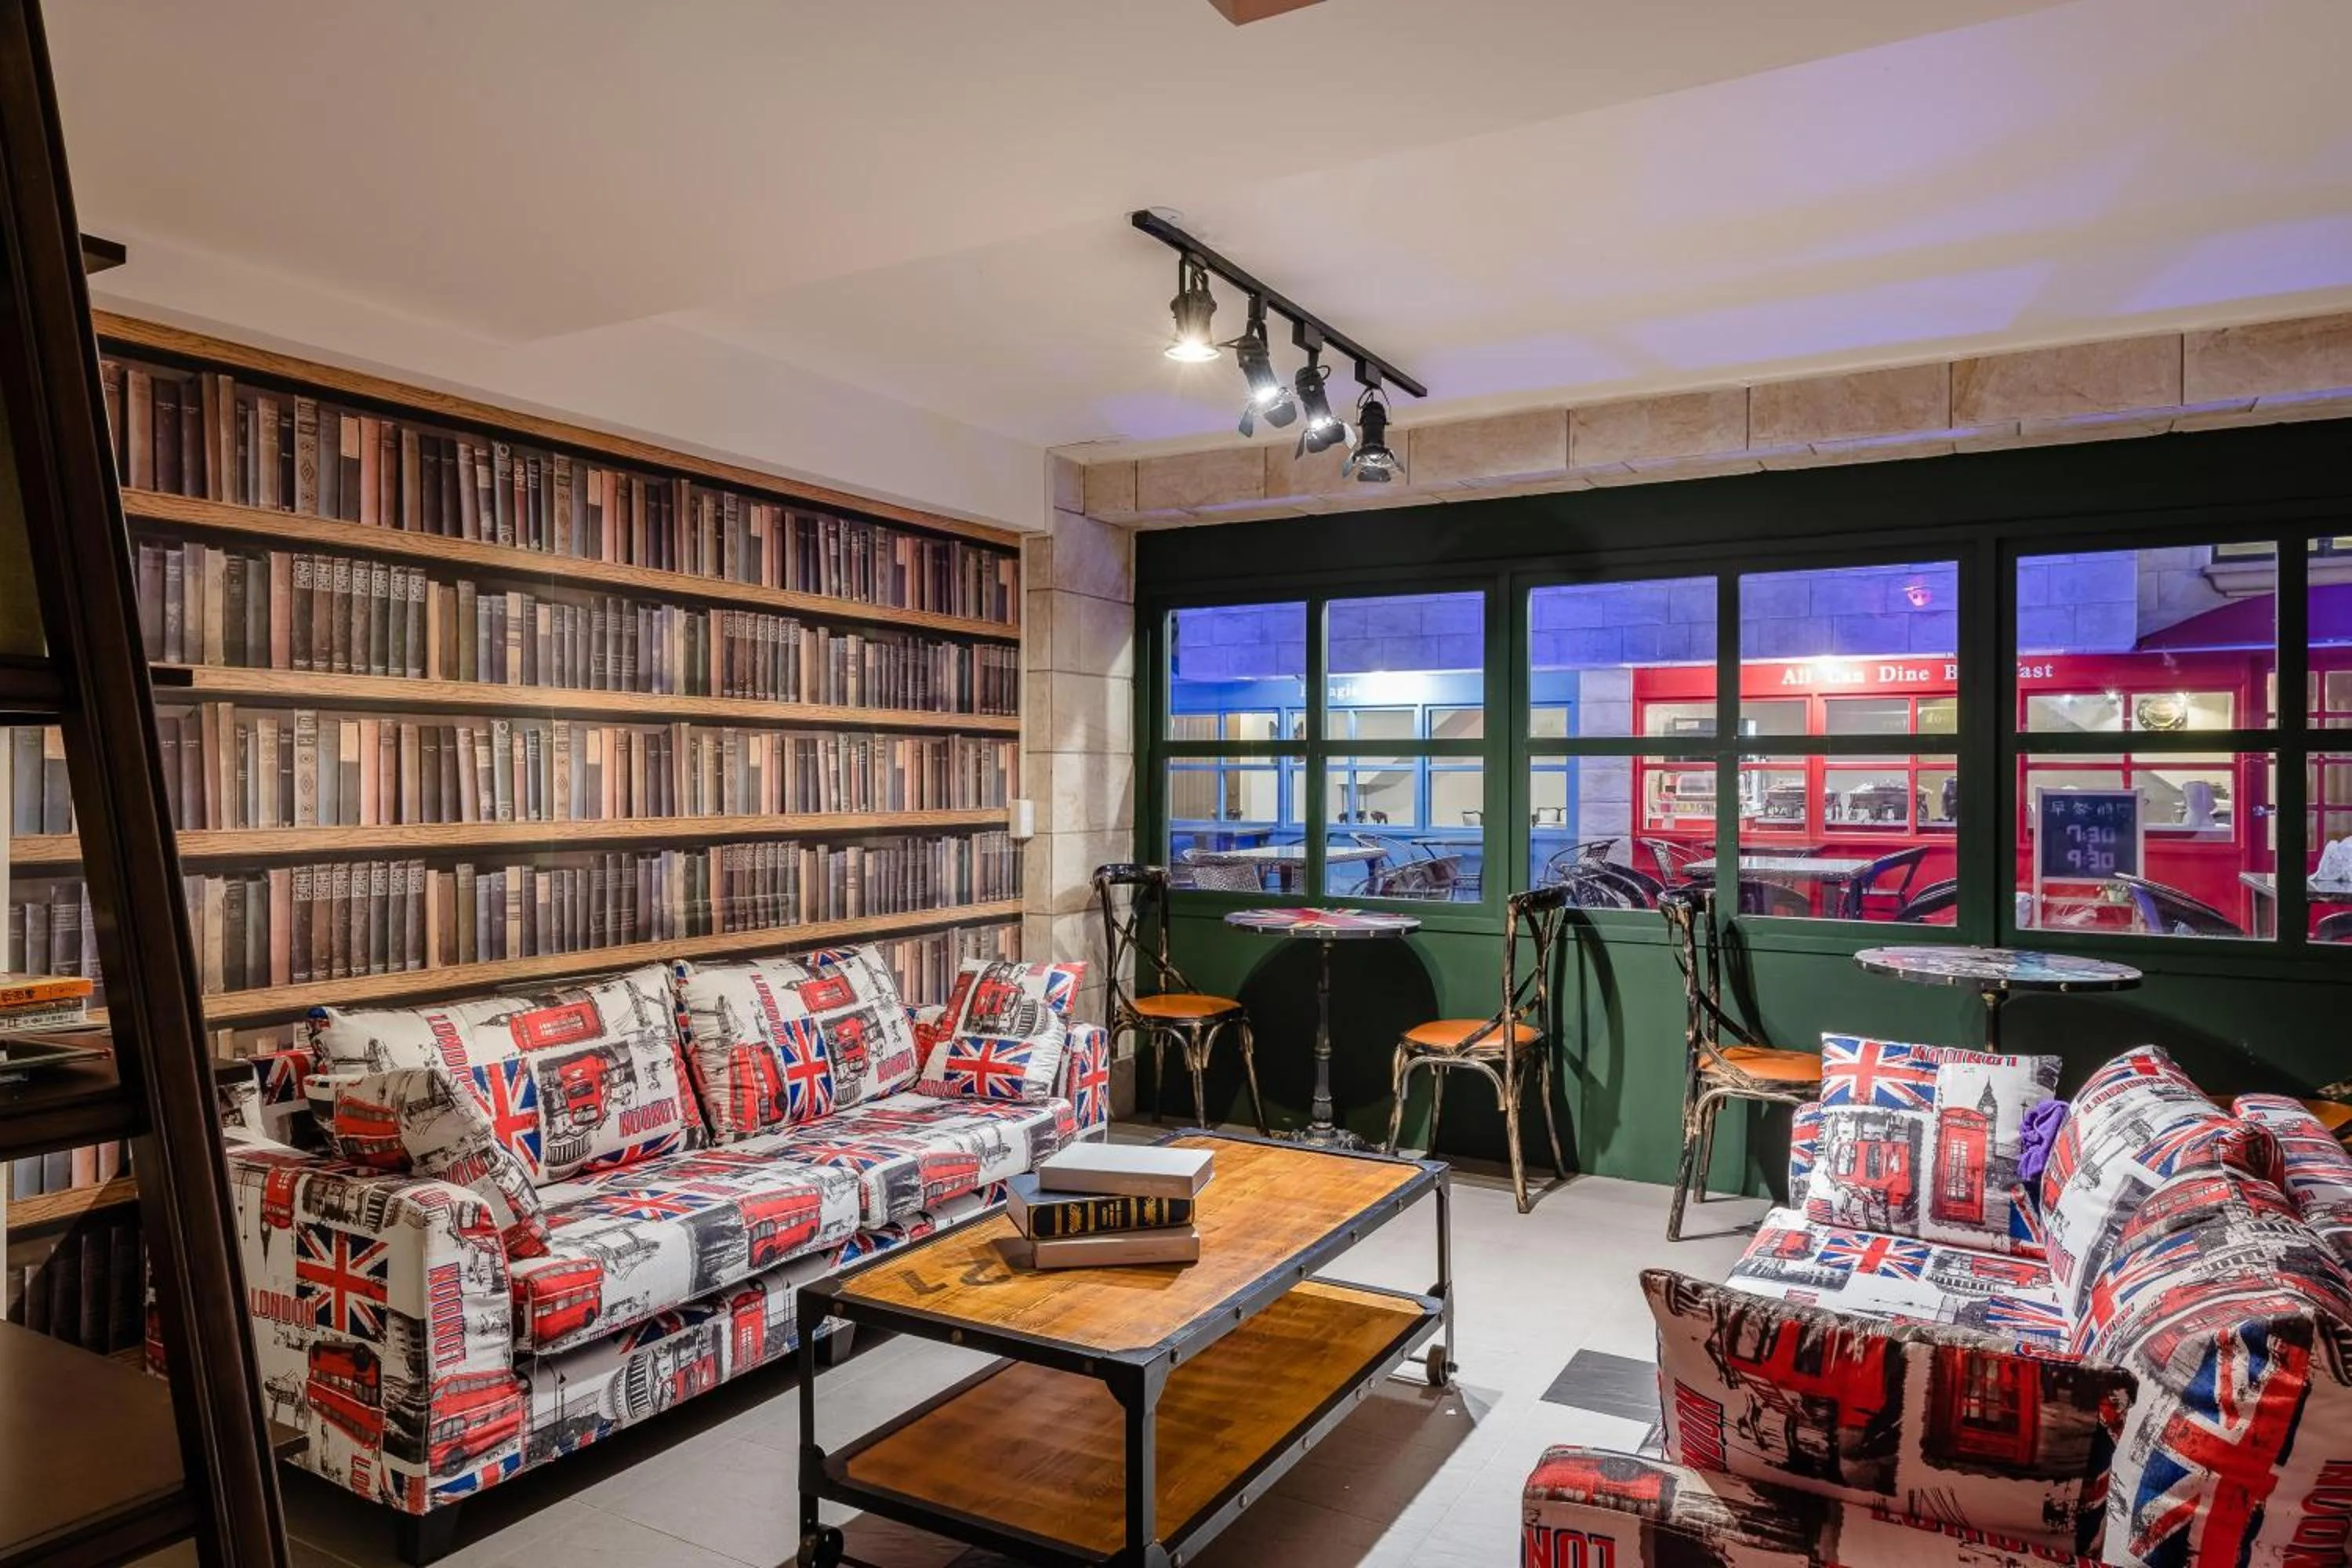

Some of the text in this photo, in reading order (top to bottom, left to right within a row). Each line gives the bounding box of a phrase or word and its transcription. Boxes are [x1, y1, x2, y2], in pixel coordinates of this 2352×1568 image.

[1780, 665, 1813, 685] All
[1878, 666, 1930, 683] Dine
[2066, 824, 2116, 844] 7:30
[2067, 849, 2115, 869] 9:30
[250, 1287, 317, 1331] LONDON
[428, 1261, 466, 1370] LONDON
